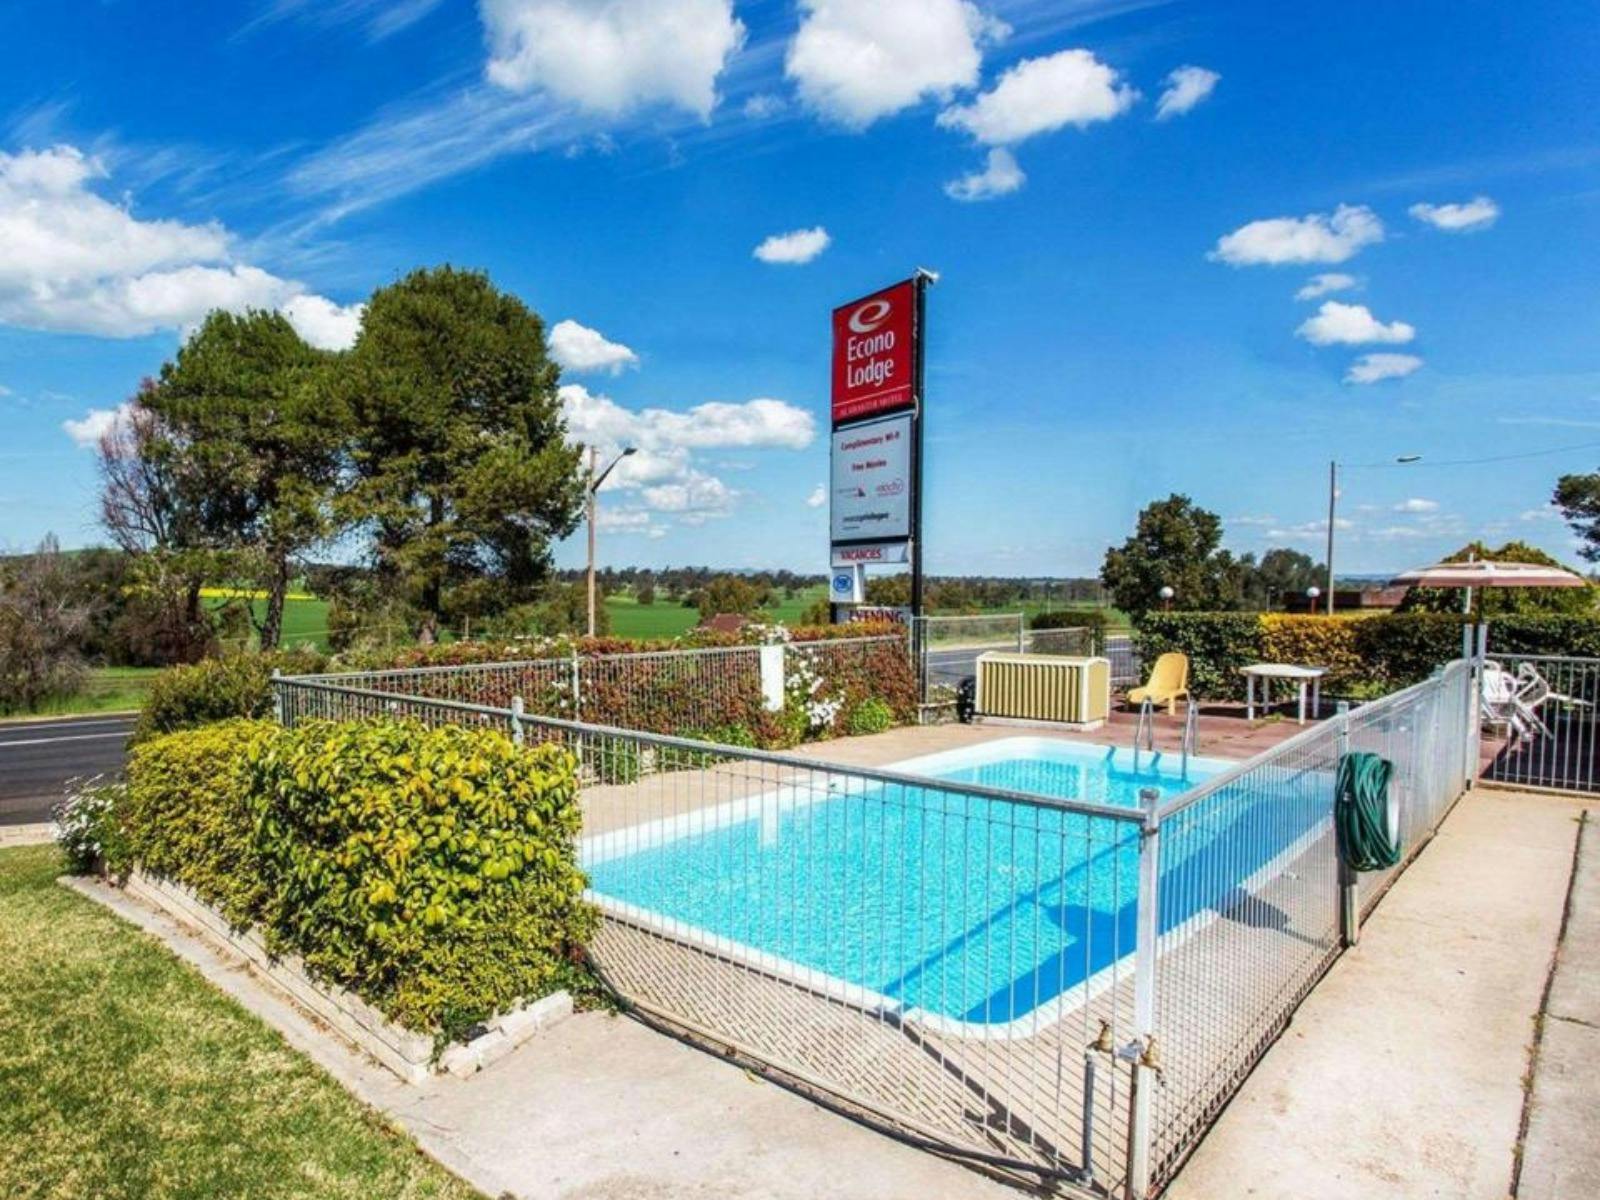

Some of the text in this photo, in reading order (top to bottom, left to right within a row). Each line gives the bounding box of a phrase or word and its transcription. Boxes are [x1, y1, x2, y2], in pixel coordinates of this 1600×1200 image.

[847, 331, 895, 361] Econo
[847, 358, 894, 388] Lodge
[841, 548, 881, 559] VACANCIES
